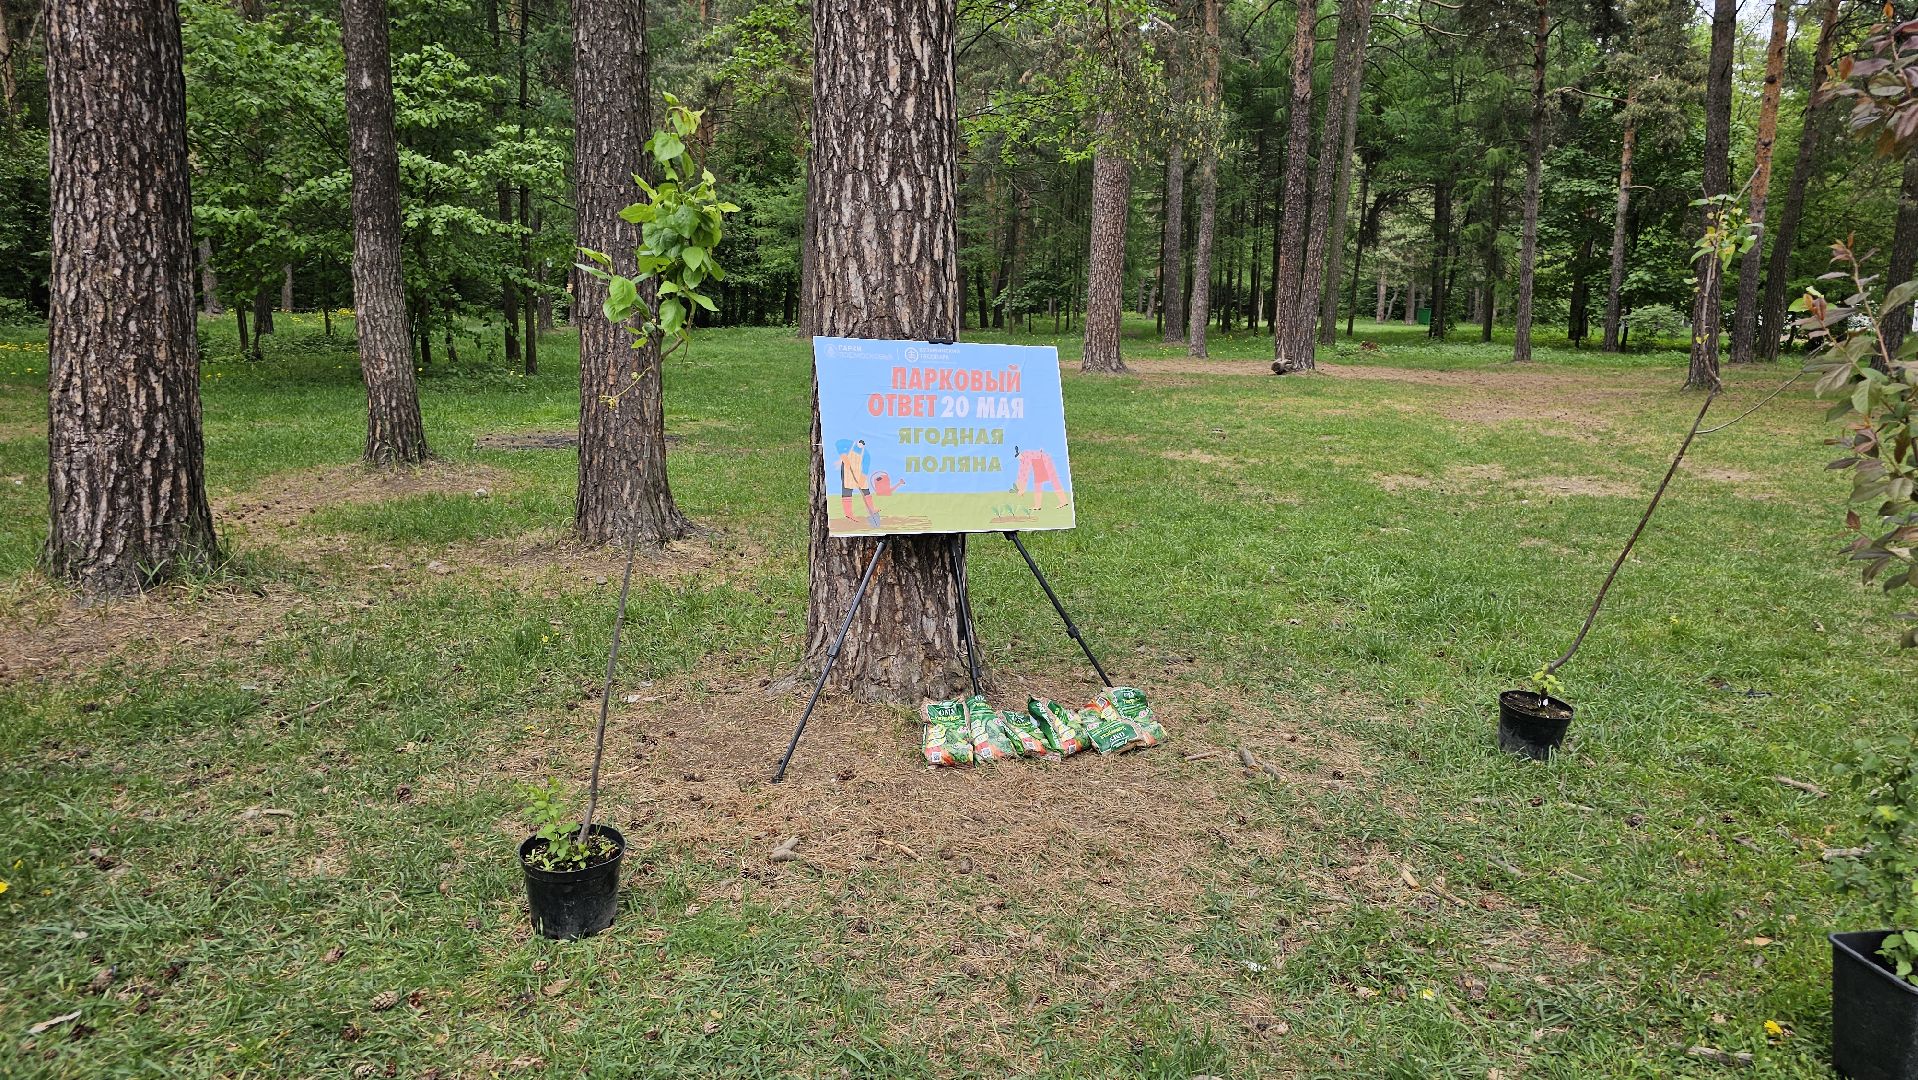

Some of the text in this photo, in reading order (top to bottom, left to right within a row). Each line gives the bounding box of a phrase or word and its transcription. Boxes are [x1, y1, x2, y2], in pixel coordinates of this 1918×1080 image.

[892, 364, 1021, 392] ПАРКОВЫЙ
[868, 393, 1024, 419] ОТВЕТ 20 МАЯ
[898, 427, 1004, 446] ЯГОДНАЯ
[906, 456, 1002, 473] ПОЛЯНА
